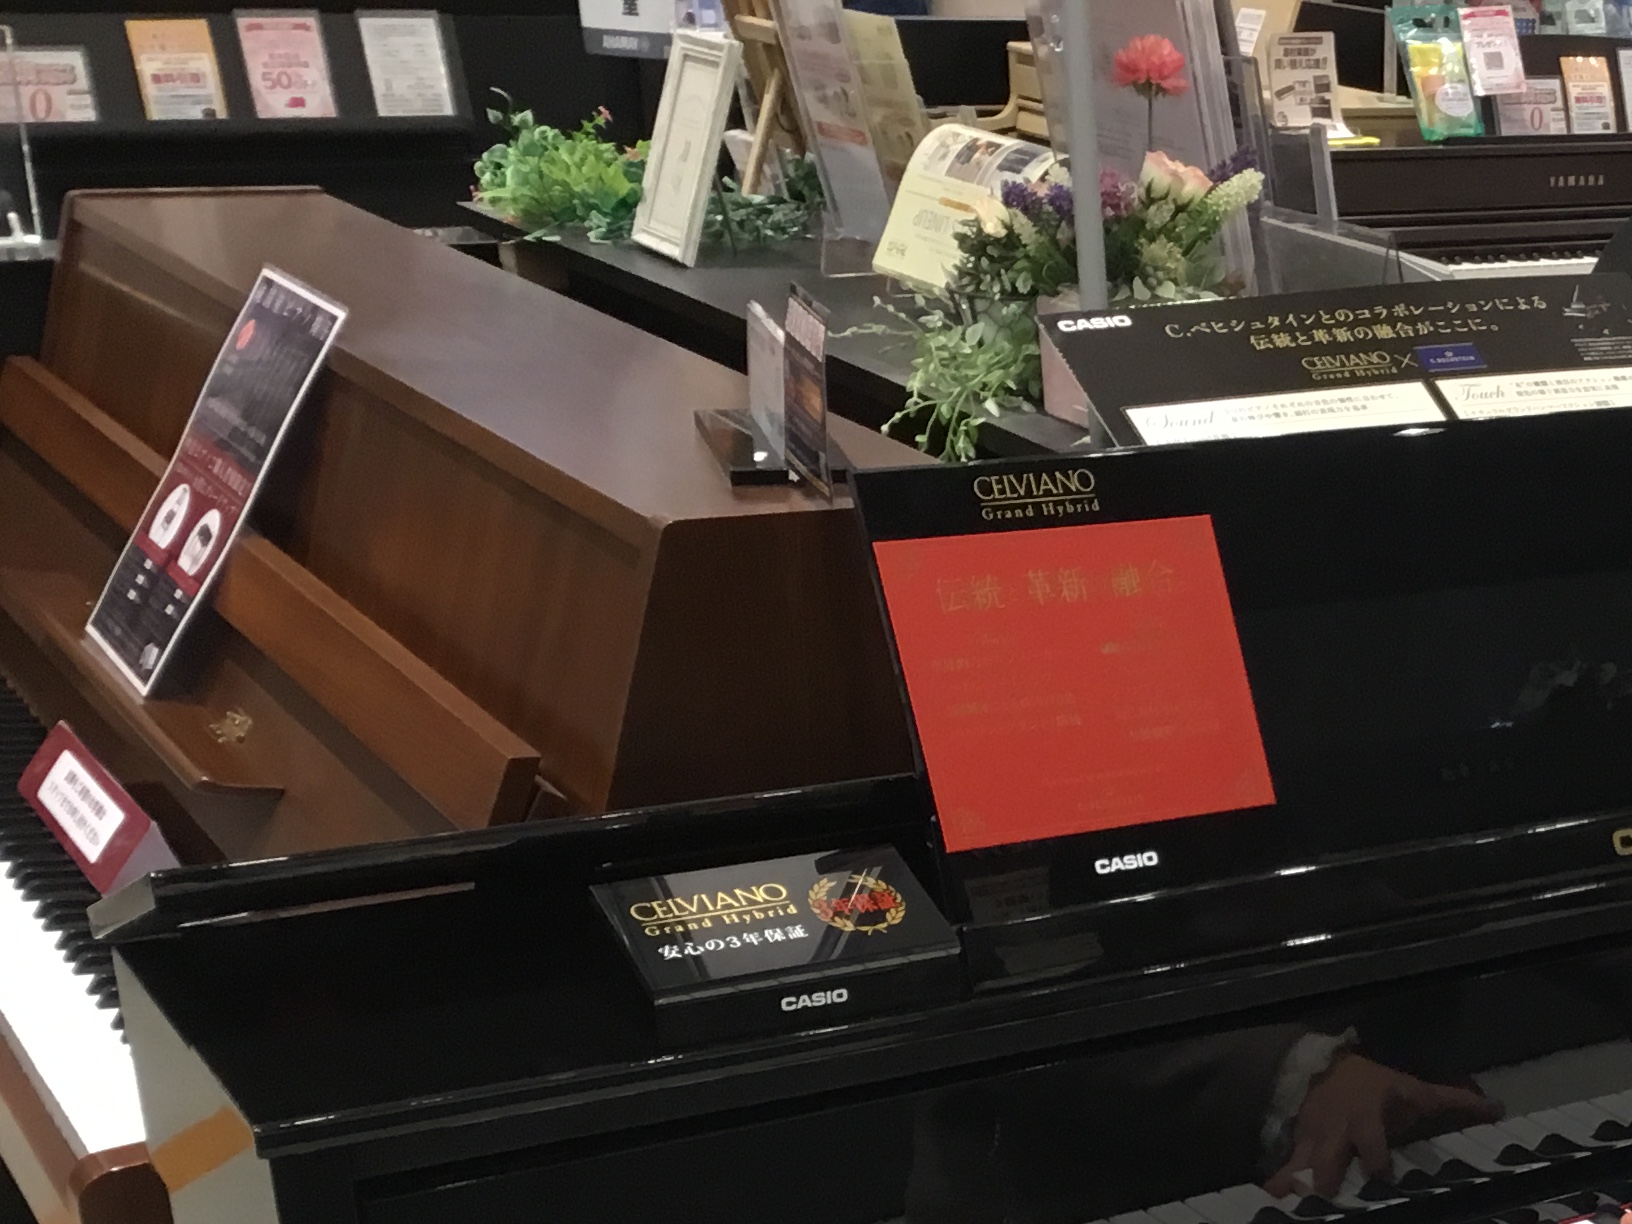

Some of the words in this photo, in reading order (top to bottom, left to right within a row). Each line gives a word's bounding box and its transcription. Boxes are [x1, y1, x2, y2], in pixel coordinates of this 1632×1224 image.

[1549, 174, 1604, 187] YAMAHA
[1057, 314, 1133, 333] CASIO
[1301, 350, 1391, 370] CELVIANO
[1312, 370, 1351, 381] Grand
[1354, 365, 1398, 378] Hybrid
[1455, 383, 1506, 401] Touch
[973, 469, 1096, 501] CELVIANO
[981, 503, 1035, 521] Grand
[1042, 498, 1101, 518] Hybrid
[1094, 850, 1159, 875] CASIO
[629, 882, 789, 923] CELVIANO
[644, 917, 712, 938] Grand
[723, 903, 799, 928] Hybrid
[657, 922, 809, 962] 安心の3年保証
[780, 988, 848, 1012] CASIO
